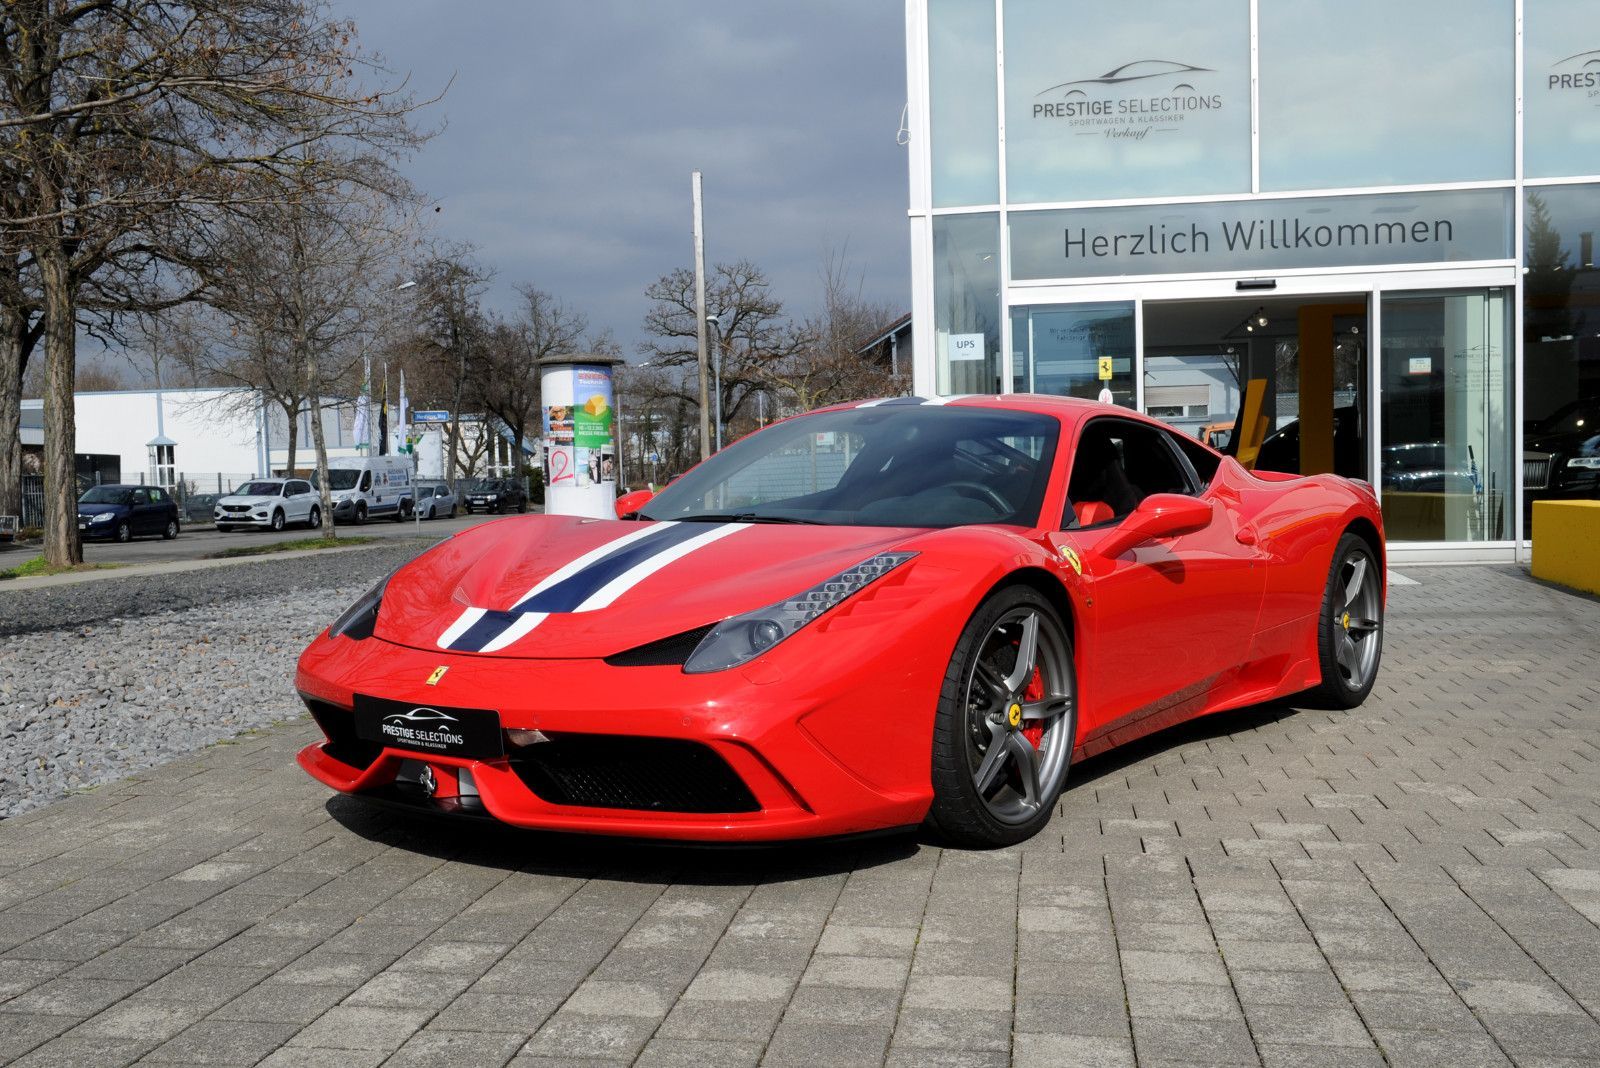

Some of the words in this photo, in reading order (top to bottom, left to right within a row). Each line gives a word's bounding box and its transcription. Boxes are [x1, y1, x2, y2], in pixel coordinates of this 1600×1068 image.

[1033, 100, 1113, 118] PRESTIGE
[1118, 95, 1222, 114] SELECTIONS
[1069, 116, 1126, 127] SPORTWAGEN
[1137, 114, 1185, 123] KLASSIKER
[1104, 126, 1152, 140] Verkauf
[1064, 223, 1209, 258] Herzlich
[1222, 218, 1453, 251] Willkommen
[956, 340, 975, 349] UPS
[382, 724, 415, 739] PRESTIGE
[415, 730, 464, 745] SELECTIONS
